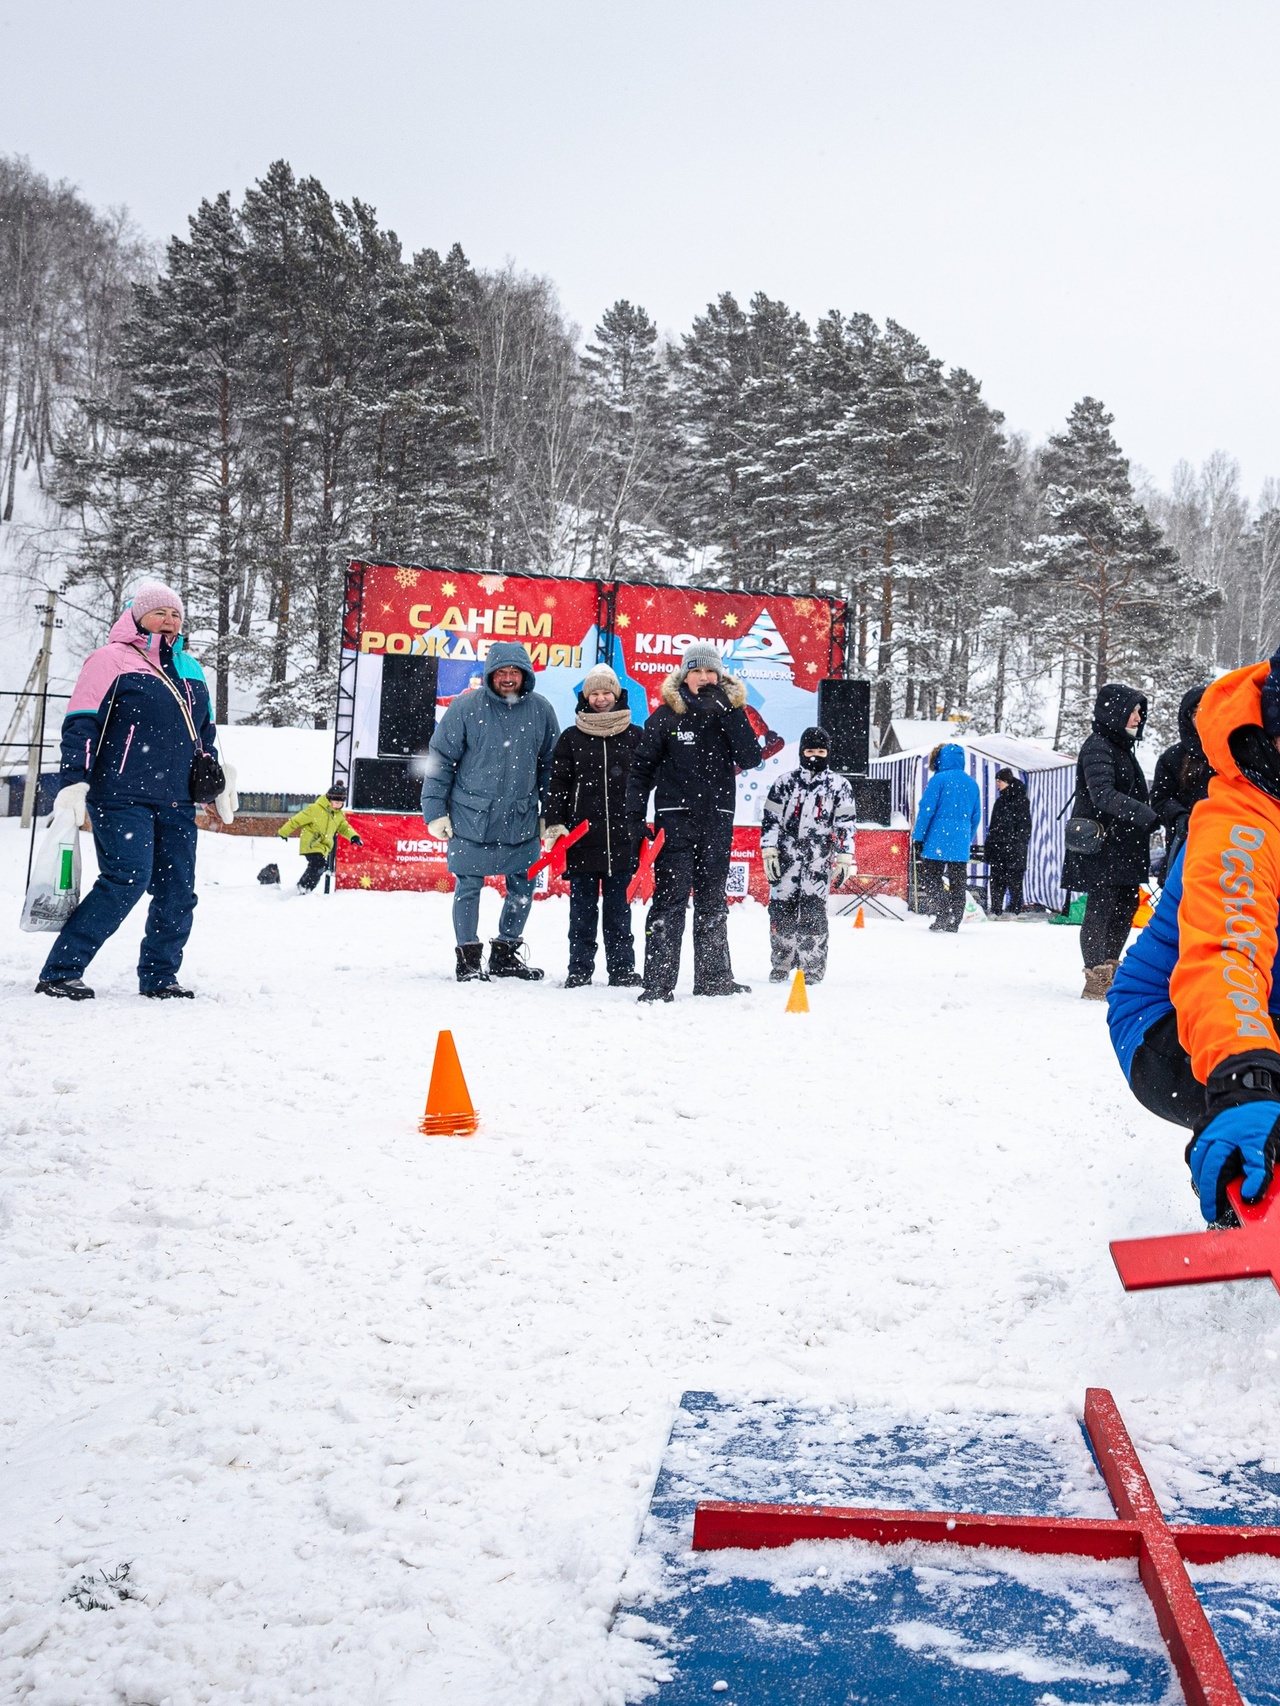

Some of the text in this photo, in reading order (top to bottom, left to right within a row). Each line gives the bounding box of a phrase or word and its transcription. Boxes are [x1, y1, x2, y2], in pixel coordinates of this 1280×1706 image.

[408, 603, 553, 638] С ДНЁМ
[360, 630, 583, 668] РОЖДЕИЯ!
[733, 667, 796, 681] комплекс
[396, 855, 448, 863] горнолыжны
